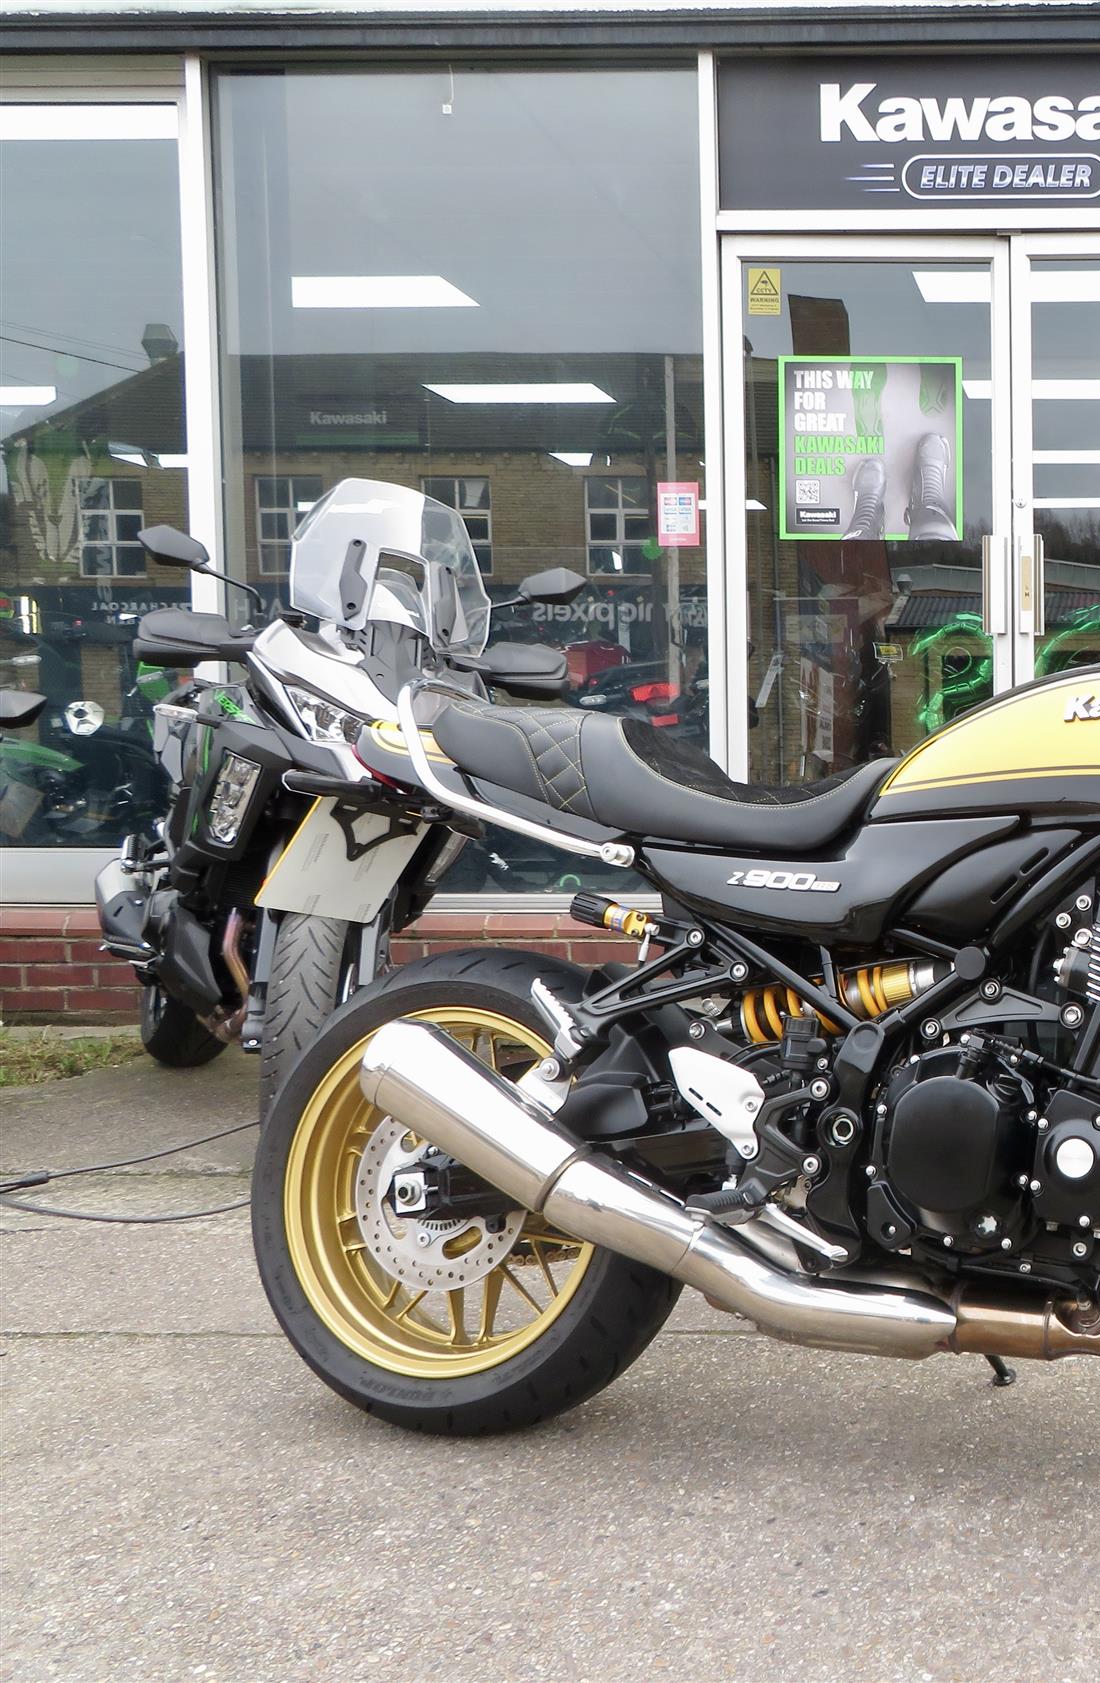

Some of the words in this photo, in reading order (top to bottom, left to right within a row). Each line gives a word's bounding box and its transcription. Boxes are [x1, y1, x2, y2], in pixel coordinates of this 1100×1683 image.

[920, 164, 988, 189] ELITE
[992, 164, 1092, 189] DEALER
[794, 370, 833, 389] THIS
[836, 370, 874, 389] WAY
[794, 392, 826, 410] FOR
[310, 410, 387, 424] Kawasaki
[794, 413, 847, 432] GREAT
[794, 435, 885, 454] KAWASAKI
[794, 456, 847, 476] DEALS
